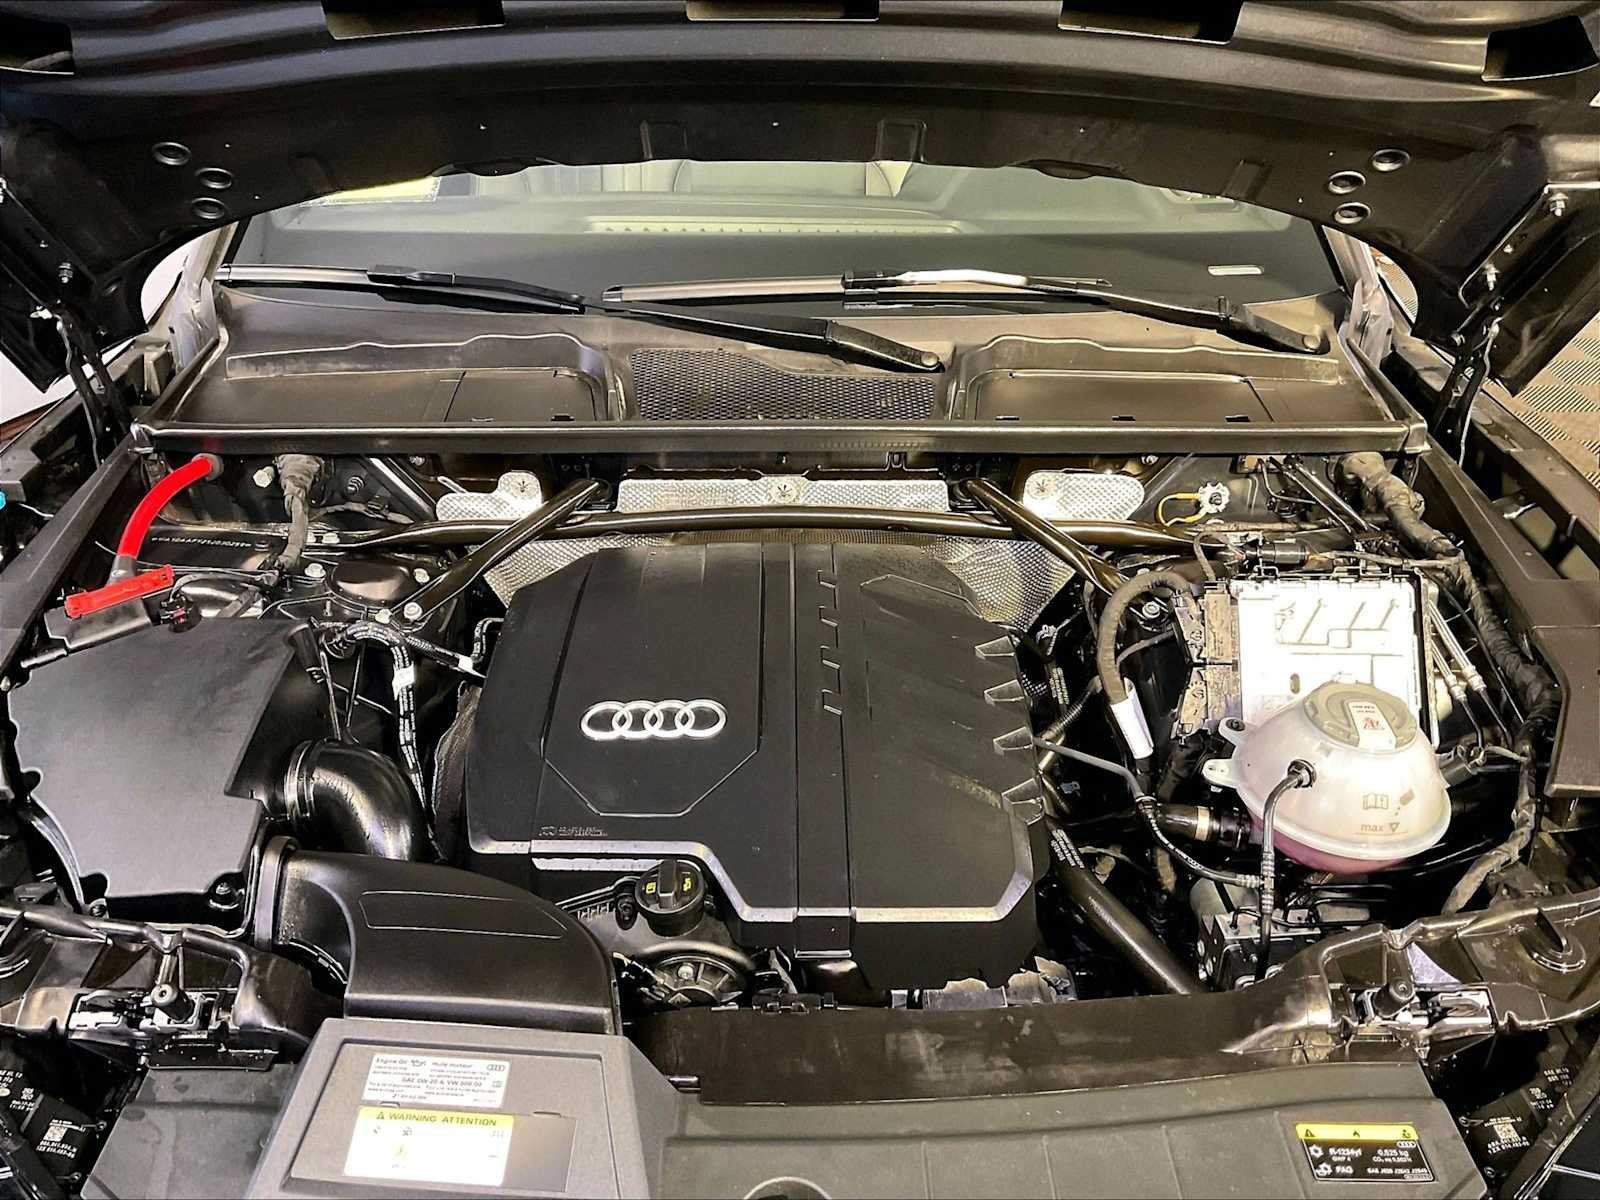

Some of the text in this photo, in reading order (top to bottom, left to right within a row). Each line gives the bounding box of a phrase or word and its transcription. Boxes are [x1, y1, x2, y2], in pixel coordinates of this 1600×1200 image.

[1360, 823, 1384, 832] max
[388, 1111, 497, 1127] WARNING ATTENTION
